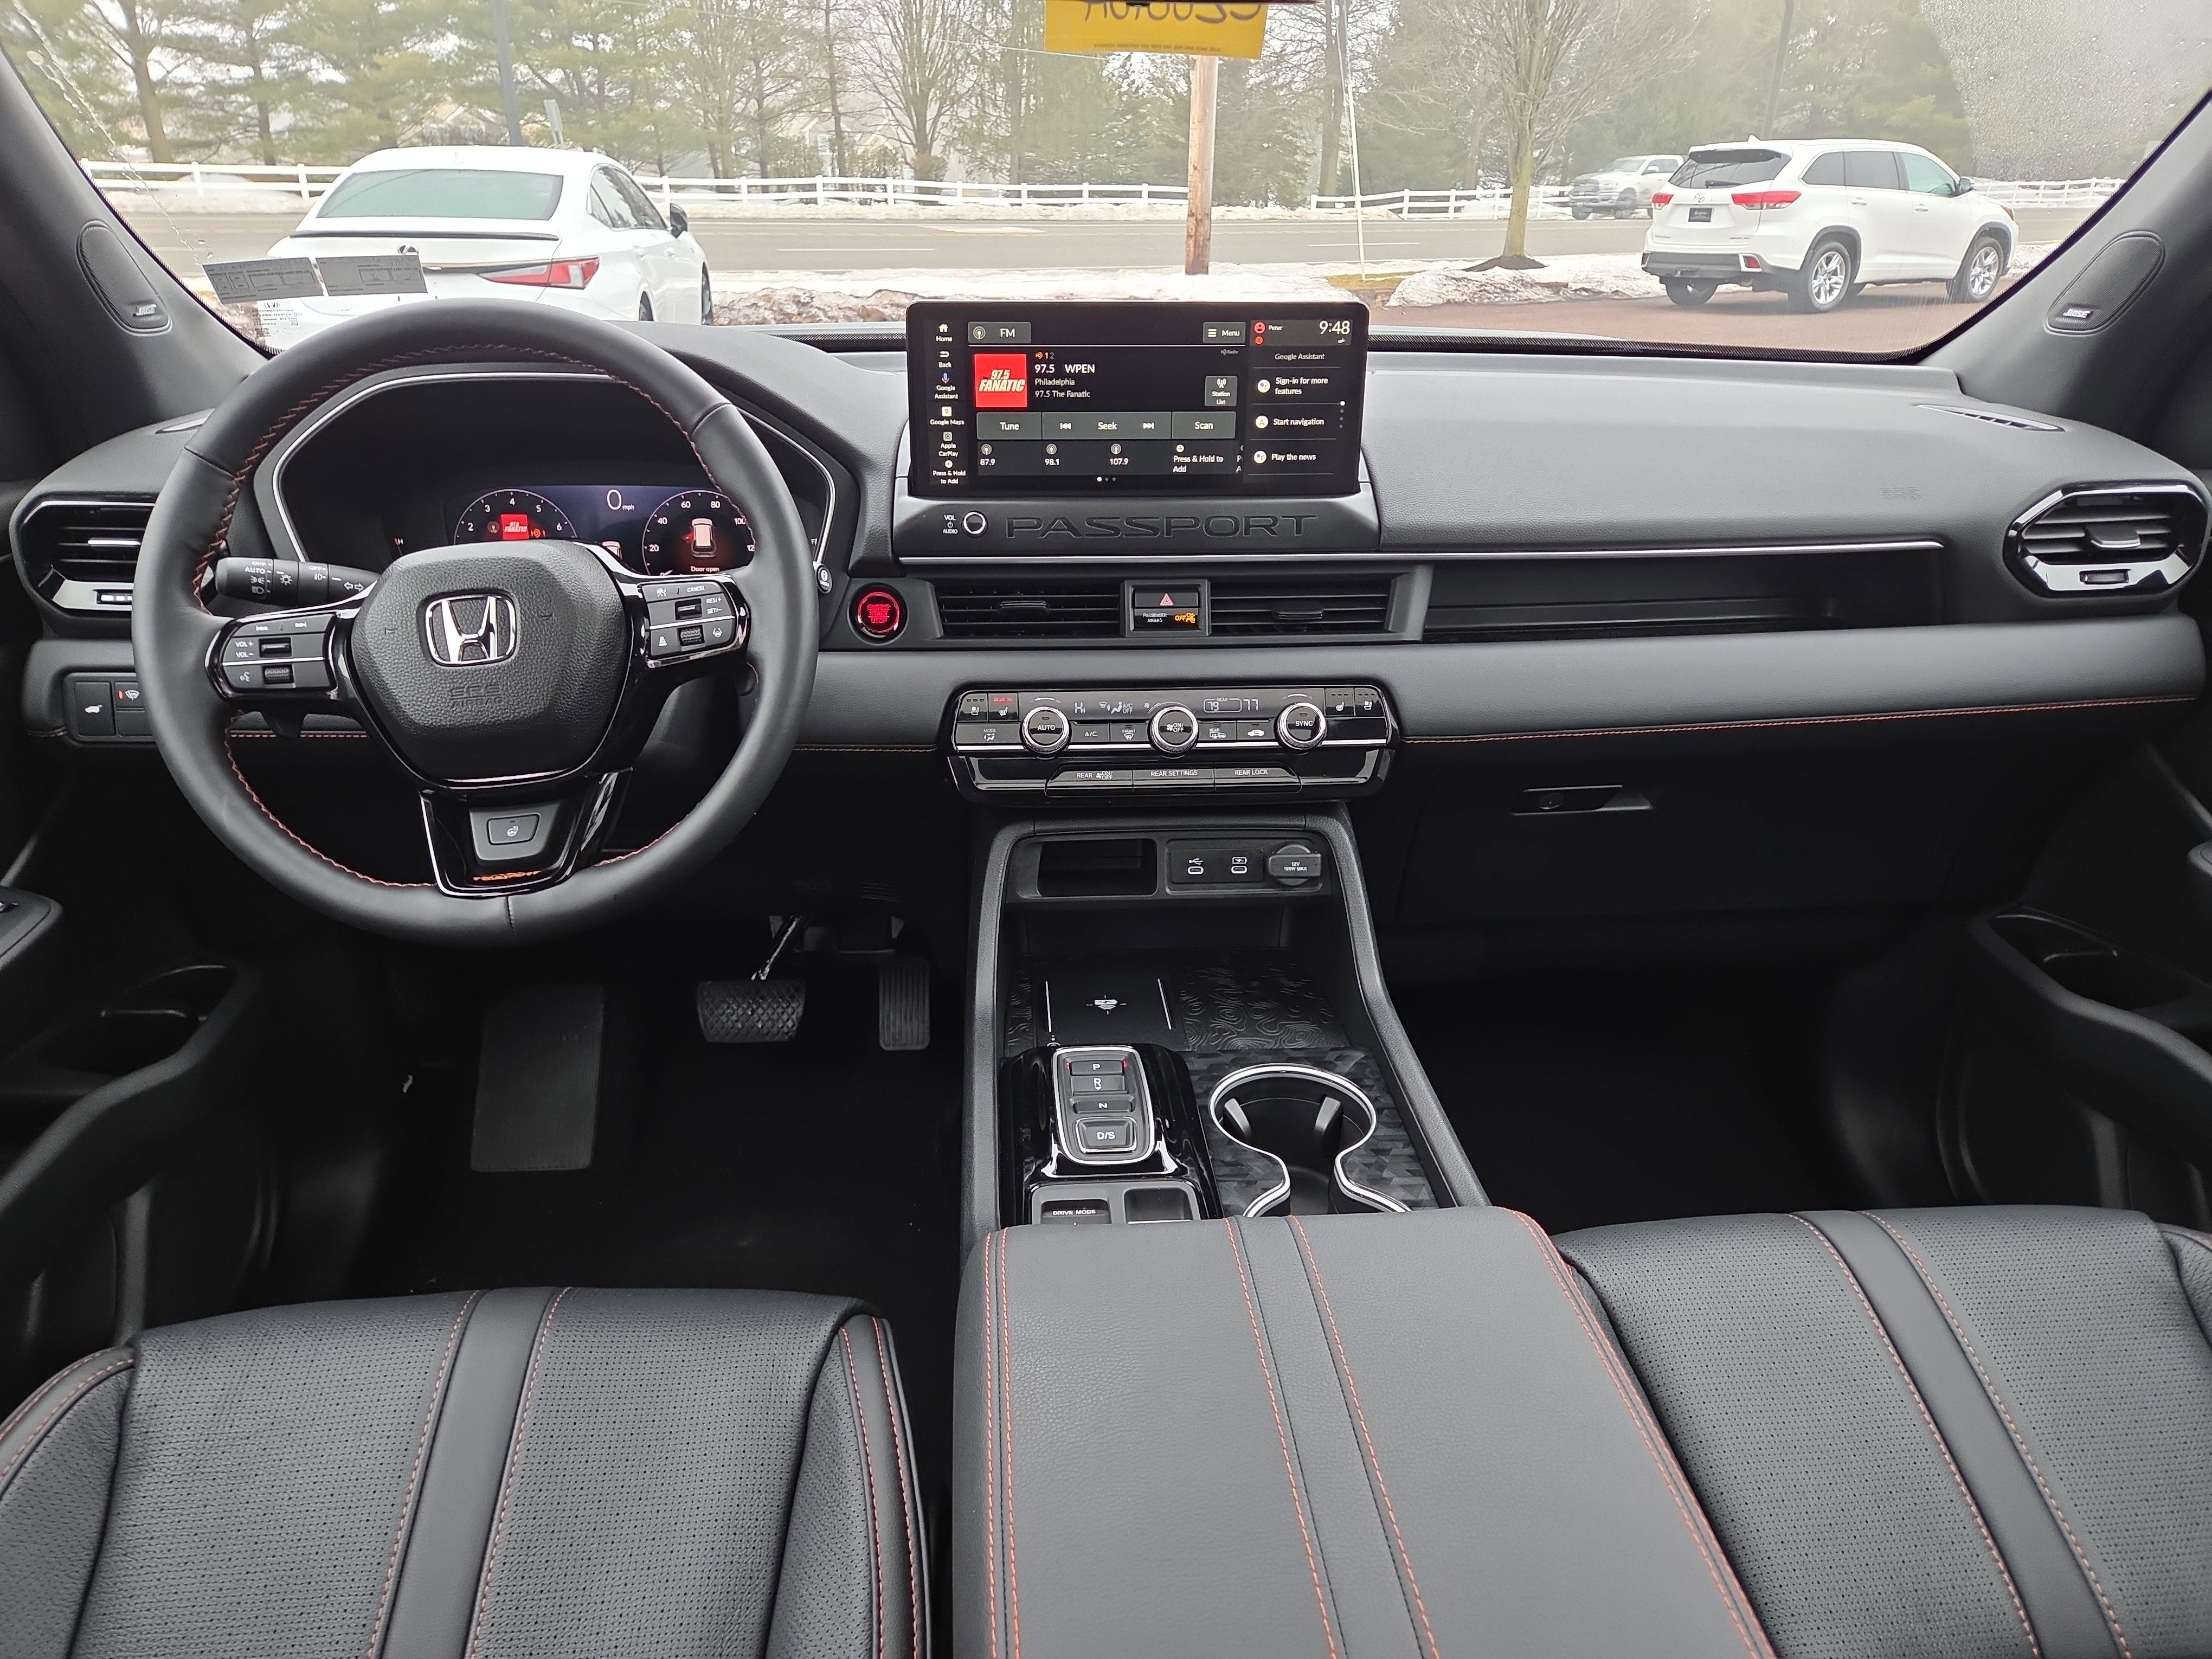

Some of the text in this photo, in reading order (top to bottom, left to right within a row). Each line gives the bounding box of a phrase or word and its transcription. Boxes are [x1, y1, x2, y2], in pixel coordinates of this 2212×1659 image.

[2063, 308, 2091, 318] BOSE
[1319, 320, 1351, 335] 9:48
[1000, 328, 1015, 338] FM
[1034, 364, 1095, 374] 97.5 WPEN
[991, 369, 1011, 380] 97.5
[979, 379, 1026, 392] FANATIC
[1035, 378, 1075, 387] Philadelphia
[1275, 377, 1298, 385] Sign-in
[999, 422, 1019, 430] Tune
[1098, 421, 1117, 430] Seek
[1194, 421, 1213, 430] Scan
[1290, 418, 1324, 426] navigation
[607, 489, 622, 510] 0
[485, 504, 490, 512] 3
[536, 504, 542, 512] 5
[681, 500, 691, 509] 60
[711, 500, 721, 509] 80
[467, 523, 474, 531] 2
[556, 523, 562, 531] 6
[1006, 515, 1317, 538] PASSPORT
[451, 684, 500, 697] SRS
[1207, 702, 1219, 711] 79
[1243, 699, 1259, 711] 77
[1094, 1078, 1101, 1086] R
[1097, 1131, 1115, 1140] D/S
